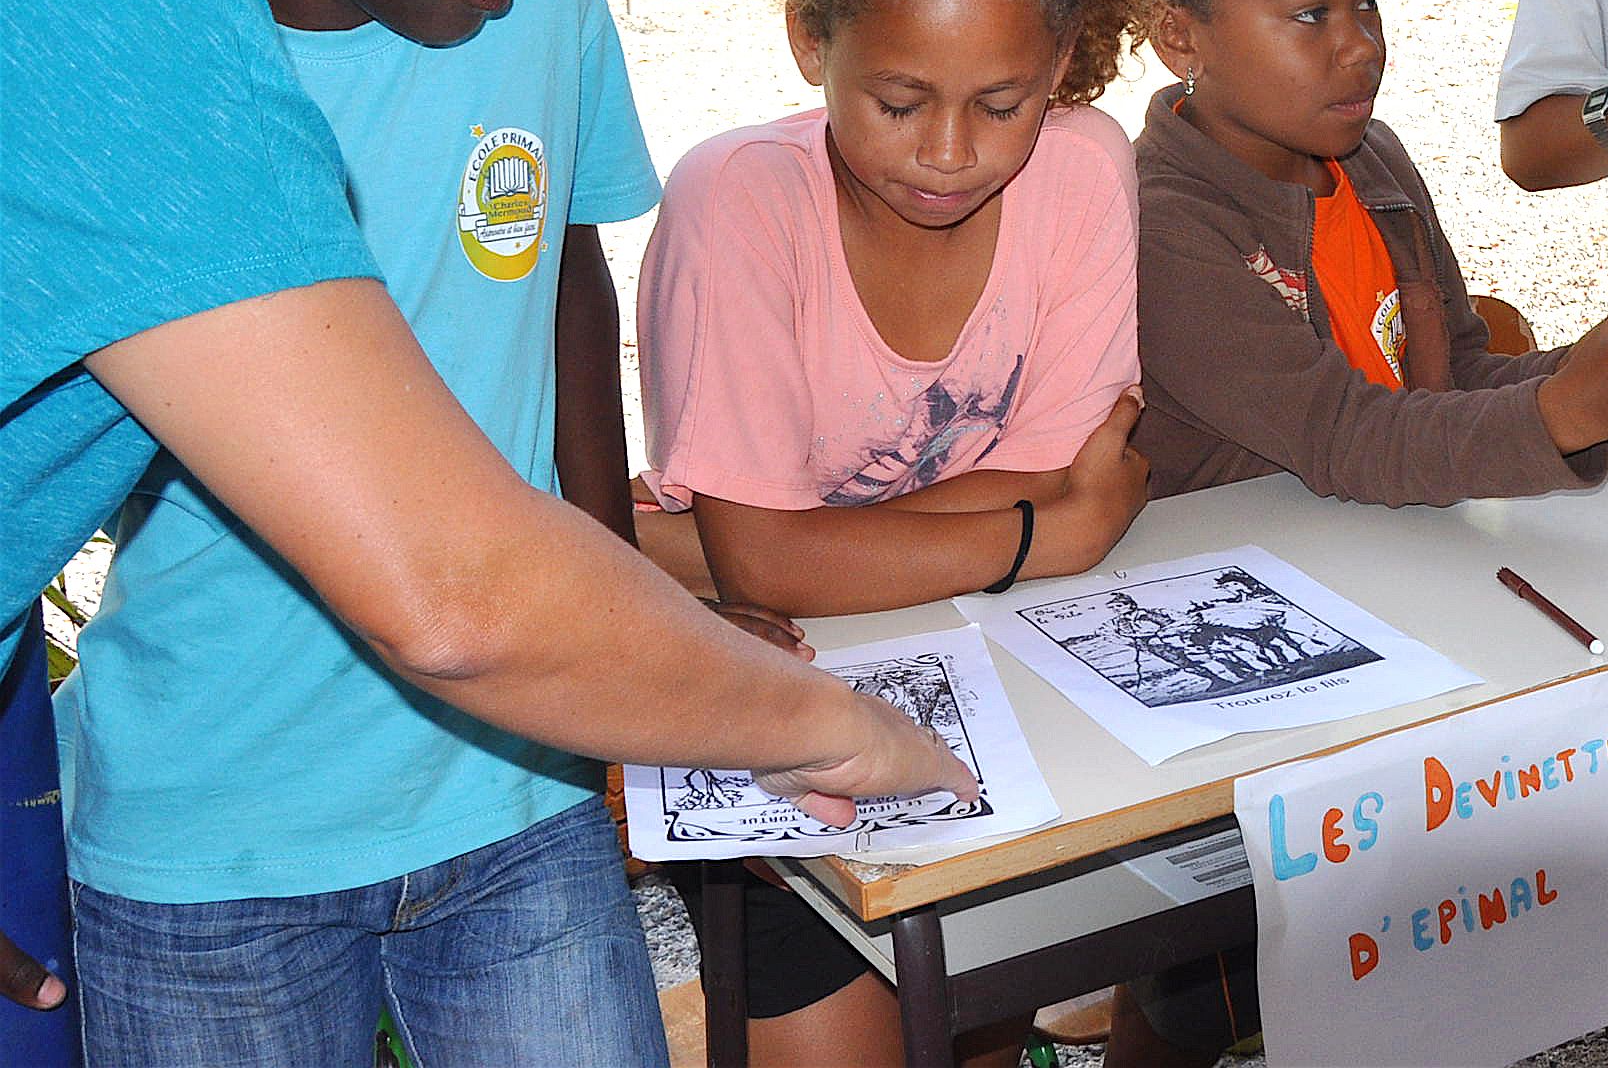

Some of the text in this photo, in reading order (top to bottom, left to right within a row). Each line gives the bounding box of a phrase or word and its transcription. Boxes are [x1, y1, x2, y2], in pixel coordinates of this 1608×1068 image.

[468, 134, 501, 182] ECOLE
[1211, 676, 1351, 710] Trouvez le fils
[737, 815, 797, 826] TORTUE
[856, 802, 900, 815] LIEVR
[1268, 791, 1384, 882] LES
[1348, 868, 1560, 982] D'EPINAL
